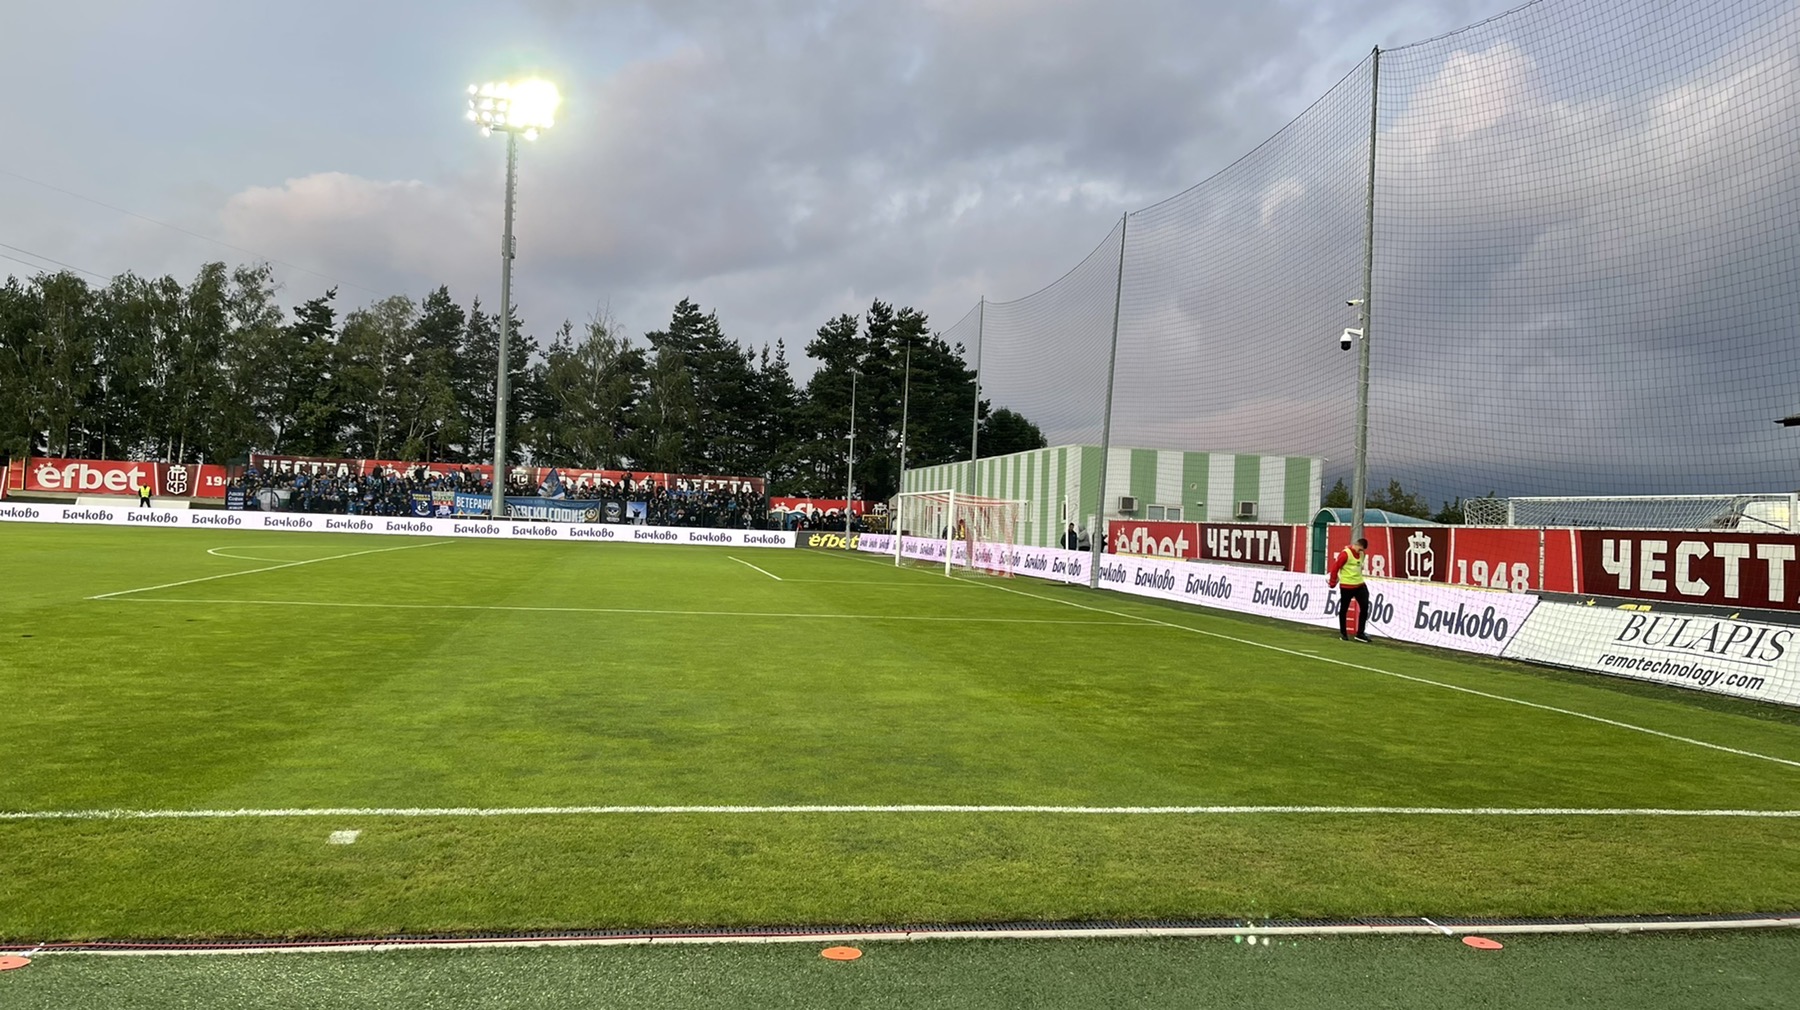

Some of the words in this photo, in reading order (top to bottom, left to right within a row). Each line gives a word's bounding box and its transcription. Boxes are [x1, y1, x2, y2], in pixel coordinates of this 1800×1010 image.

[36, 464, 146, 492] efbet
[0, 507, 39, 518] ачково
[62, 509, 113, 521] Бачково
[127, 511, 178, 523] Бачково
[192, 514, 241, 526] Бачково
[264, 516, 312, 528] Бачково
[326, 519, 373, 530] Бачково
[386, 521, 433, 532] Бачково
[454, 524, 500, 535] Бачково
[512, 525, 557, 536] Бачково
[570, 527, 614, 538] Бачково
[634, 530, 678, 541] Бачково
[689, 532, 732, 543] Бачково
[744, 534, 786, 545] Бачково
[808, 533, 859, 548] efbet
[1207, 528, 1282, 562] ЧЕСТТА
[1457, 559, 1530, 593] 1948
[1602, 539, 1800, 604] ЧЕСТТ
[1024, 554, 1047, 571] Бачково
[1052, 557, 1081, 577] Бачово
[1098, 562, 1126, 584] ачково
[1135, 567, 1175, 591] Бачково
[1185, 573, 1232, 599] Бачково
[1252, 581, 1309, 611] Бачково
[1414, 600, 1508, 642] Бачково
[1614, 614, 1794, 663] BULAPIS
[1597, 652, 1765, 691] remotechnology.com
